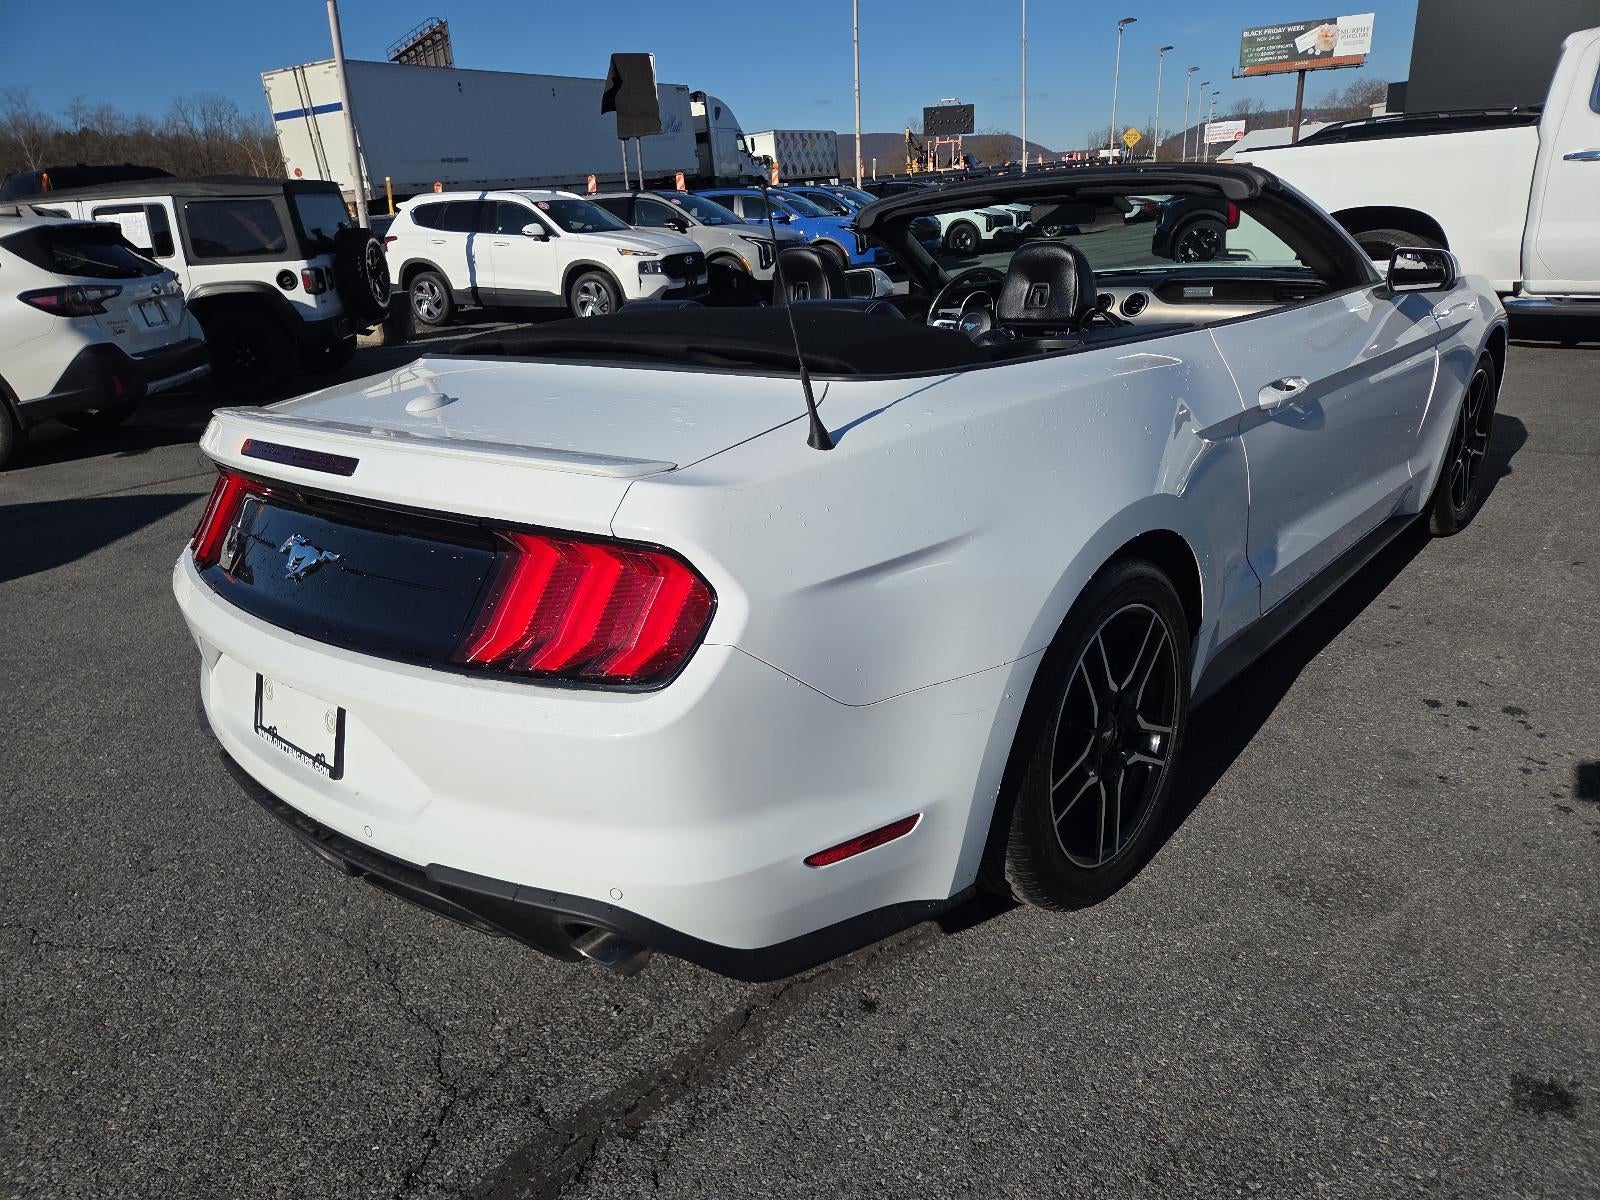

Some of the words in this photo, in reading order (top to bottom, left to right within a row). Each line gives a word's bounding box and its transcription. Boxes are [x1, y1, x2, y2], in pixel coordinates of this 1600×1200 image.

[1243, 30, 1263, 38] BLACK
[1264, 26, 1287, 35] FRIDAY
[1287, 24, 1305, 33] WEEK
[1340, 26, 1370, 35] MURPHY
[258, 728, 330, 777] WWW.OUTTENCARS.COM
